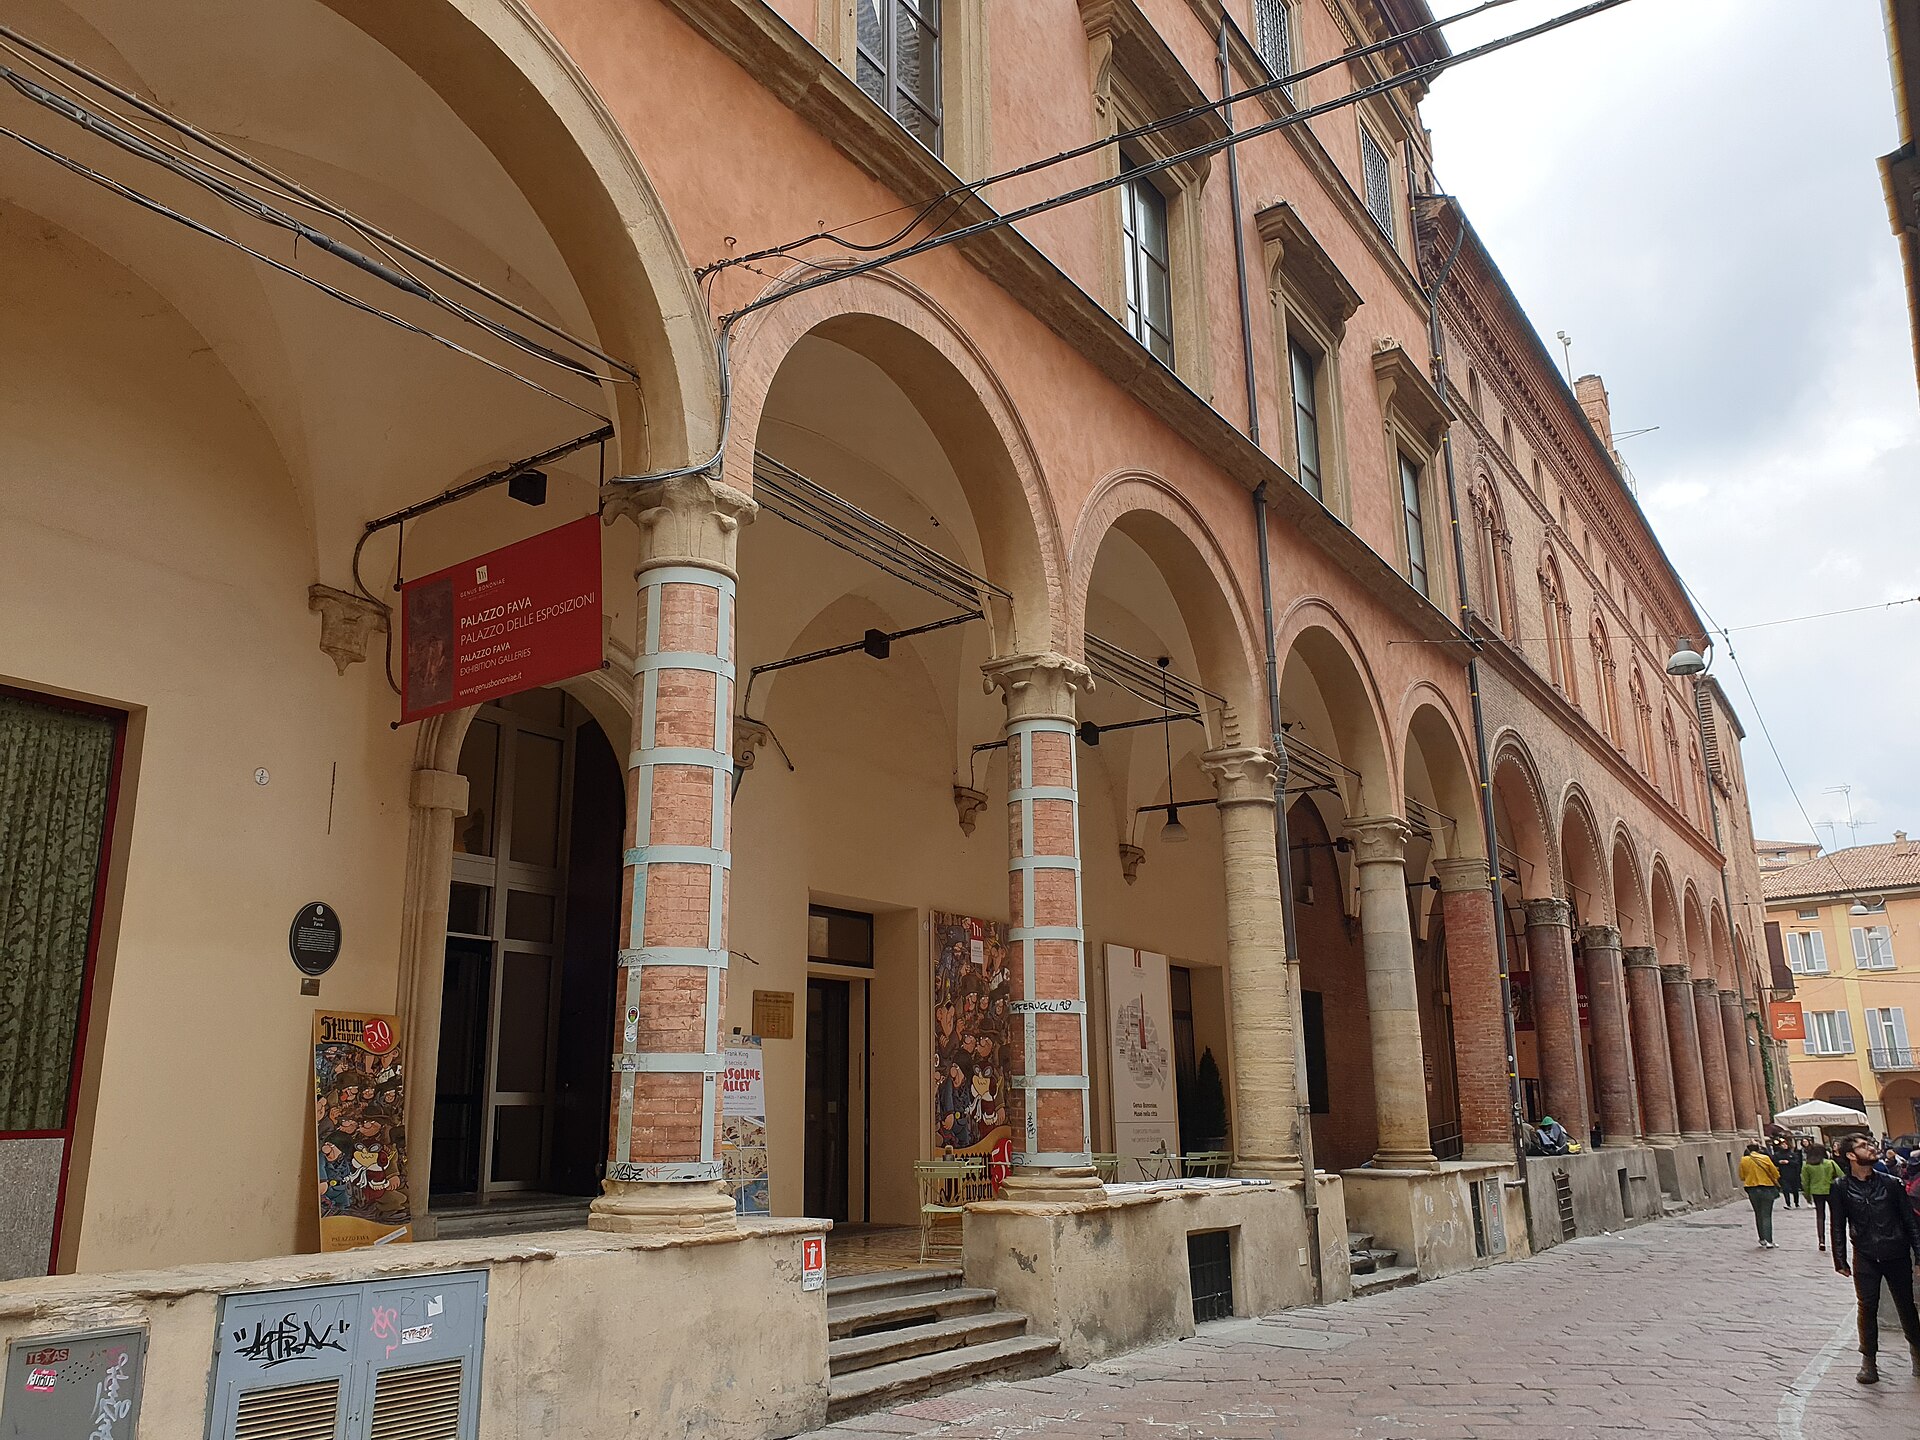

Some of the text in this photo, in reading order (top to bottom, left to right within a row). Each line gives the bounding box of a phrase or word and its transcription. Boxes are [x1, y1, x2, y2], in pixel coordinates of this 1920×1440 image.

[459, 586, 478, 598] GENUS
[478, 577, 507, 592] BONONIAE
[460, 596, 533, 629] PALAZZO FAVA
[460, 591, 596, 647] PALAZZO DELLE ESPOSIZIONI
[459, 647, 532, 677] EXHIBITION GALLERIES
[460, 641, 512, 664] PALAZZO FAVA
[458, 671, 523, 697] www.genusbononiae.it
[365, 1020, 391, 1044] 50
[724, 1050, 749, 1059] Frank King
[723, 1067, 761, 1081] ASOLINE
[723, 1079, 751, 1092] ALLEY
[29, 1350, 68, 1364] TEXAS
